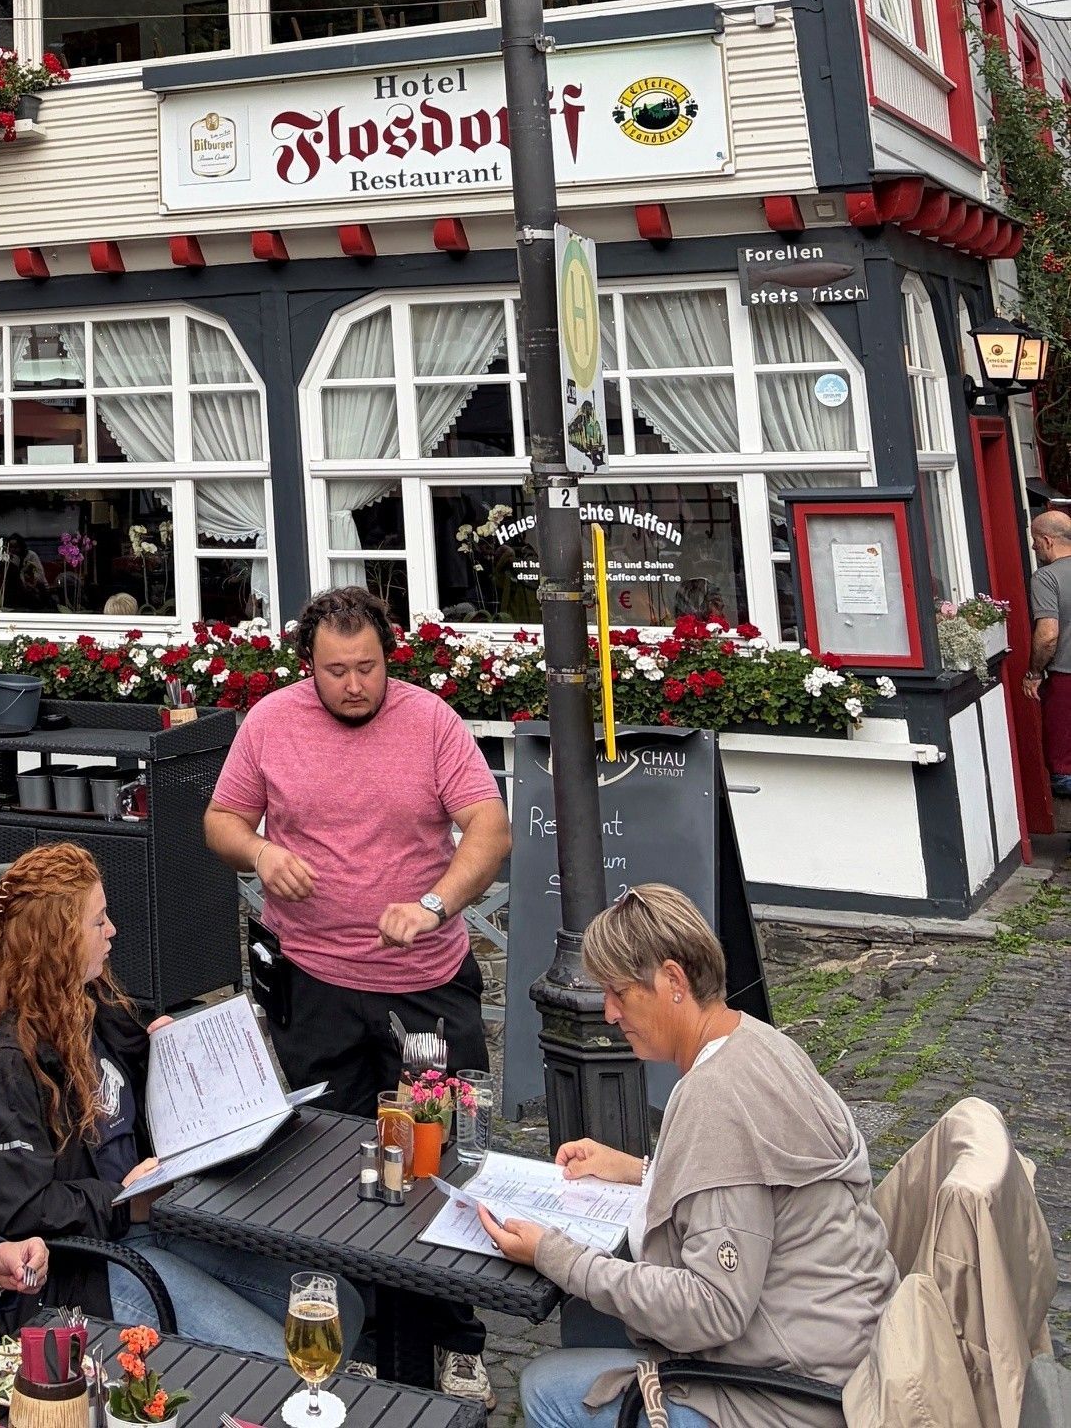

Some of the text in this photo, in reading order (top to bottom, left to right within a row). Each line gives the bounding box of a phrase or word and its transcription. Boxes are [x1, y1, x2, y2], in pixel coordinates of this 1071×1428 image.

[374, 68, 468, 100] Hotel
[629, 78, 677, 95] Eifeler
[271, 83, 585, 185] Flosdorf
[629, 127, 683, 143] Landbier
[194, 139, 233, 151] Bitburger
[349, 161, 503, 192] Restaurant
[745, 245, 823, 262] Forellen
[751, 289, 799, 304] stets
[561, 489, 571, 507] 2
[619, 505, 682, 546] Waffeln
[513, 561, 528, 569] mit
[608, 561, 622, 569] Eis
[624, 561, 642, 569] und
[644, 561, 674, 569] Sahne
[517, 573, 539, 581] dazu
[606, 574, 637, 582] Kaffee
[639, 574, 660, 582] oder
[663, 574, 681, 582] Tee
[643, 767, 685, 777] ALTSTADT
